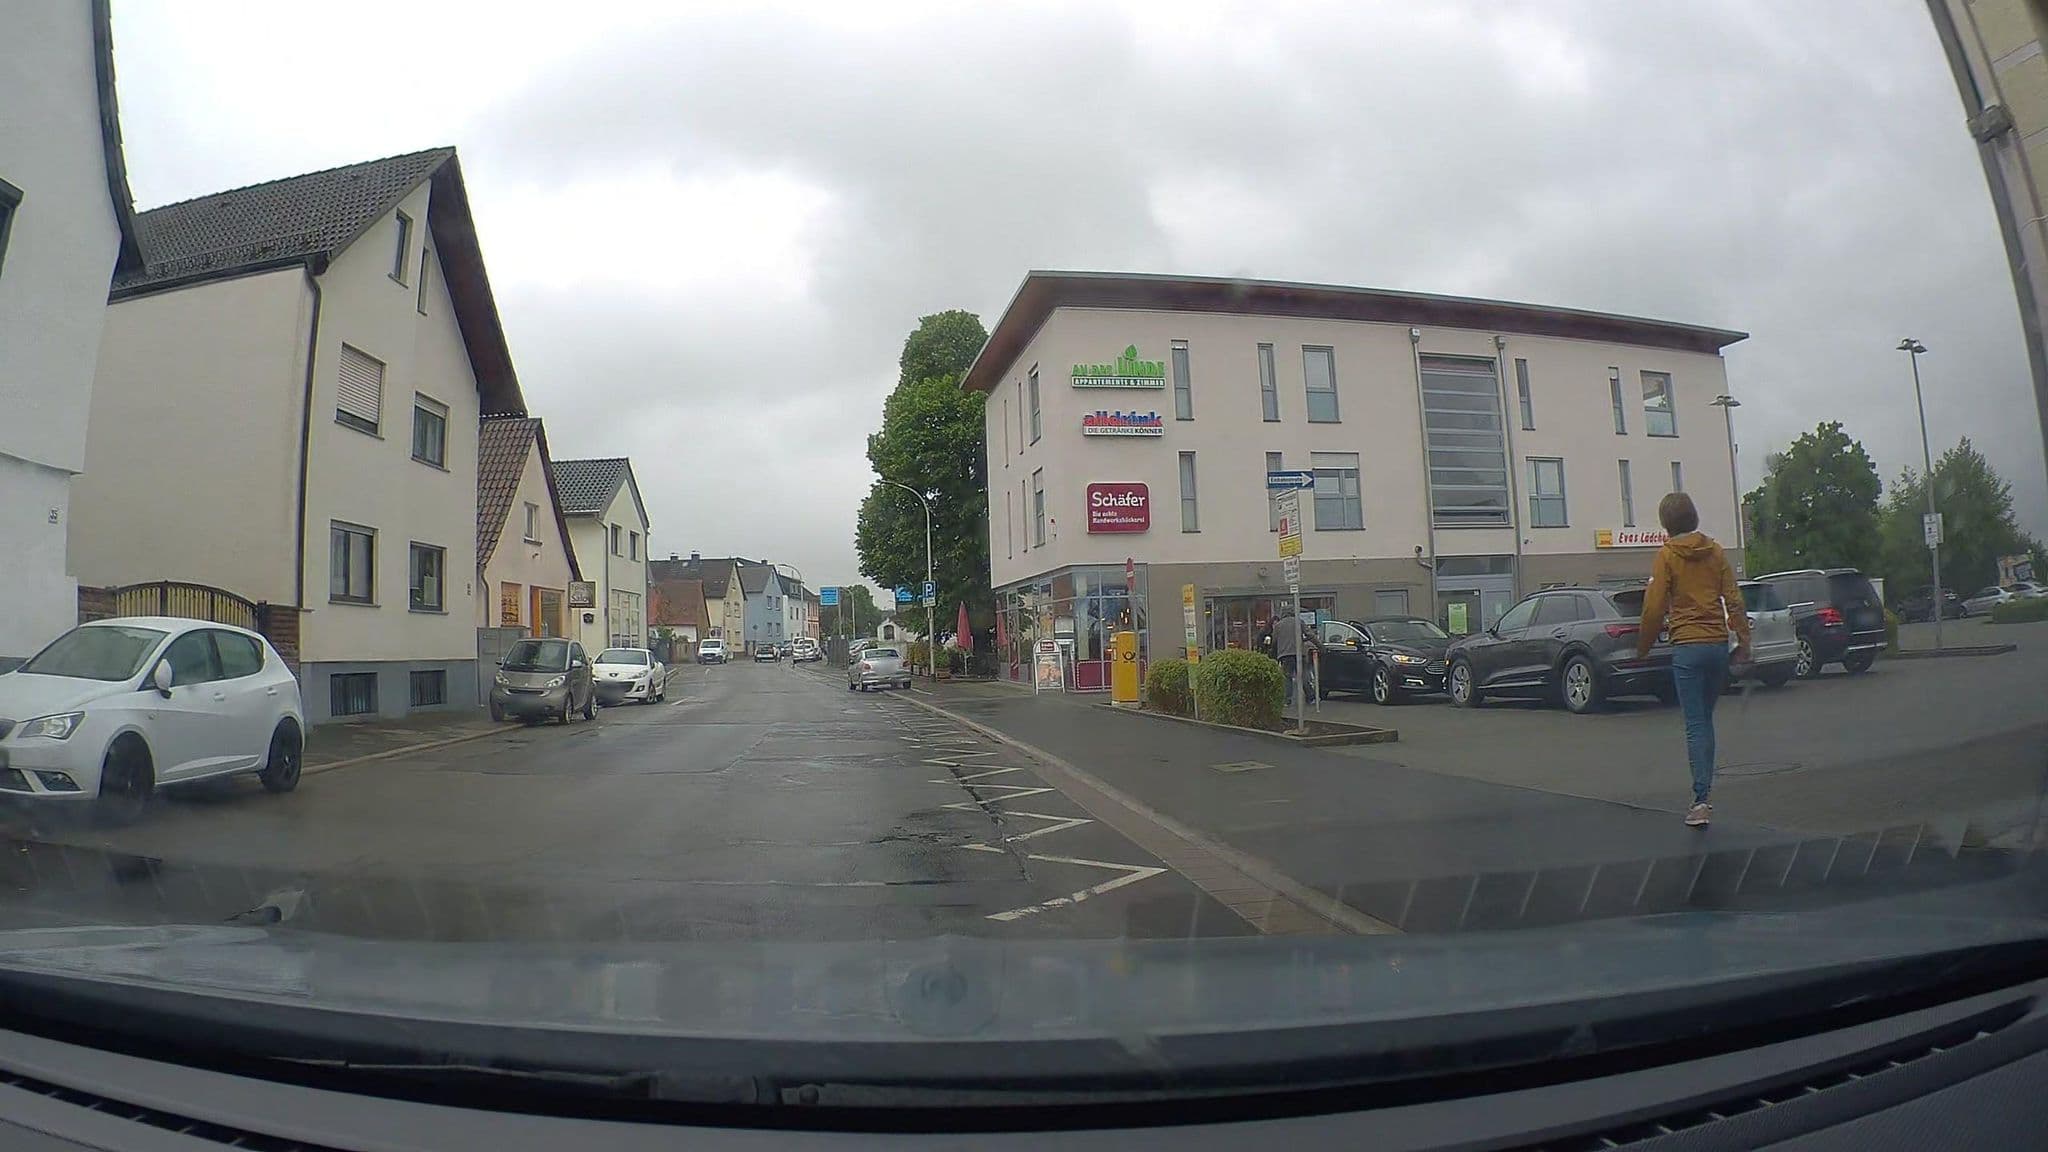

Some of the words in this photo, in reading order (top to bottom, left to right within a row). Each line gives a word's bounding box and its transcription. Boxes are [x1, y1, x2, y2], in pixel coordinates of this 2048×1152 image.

[1083, 411, 1162, 426] alldrink
[1092, 492, 1145, 506] Schäfer
[1618, 532, 1638, 544] Evas
